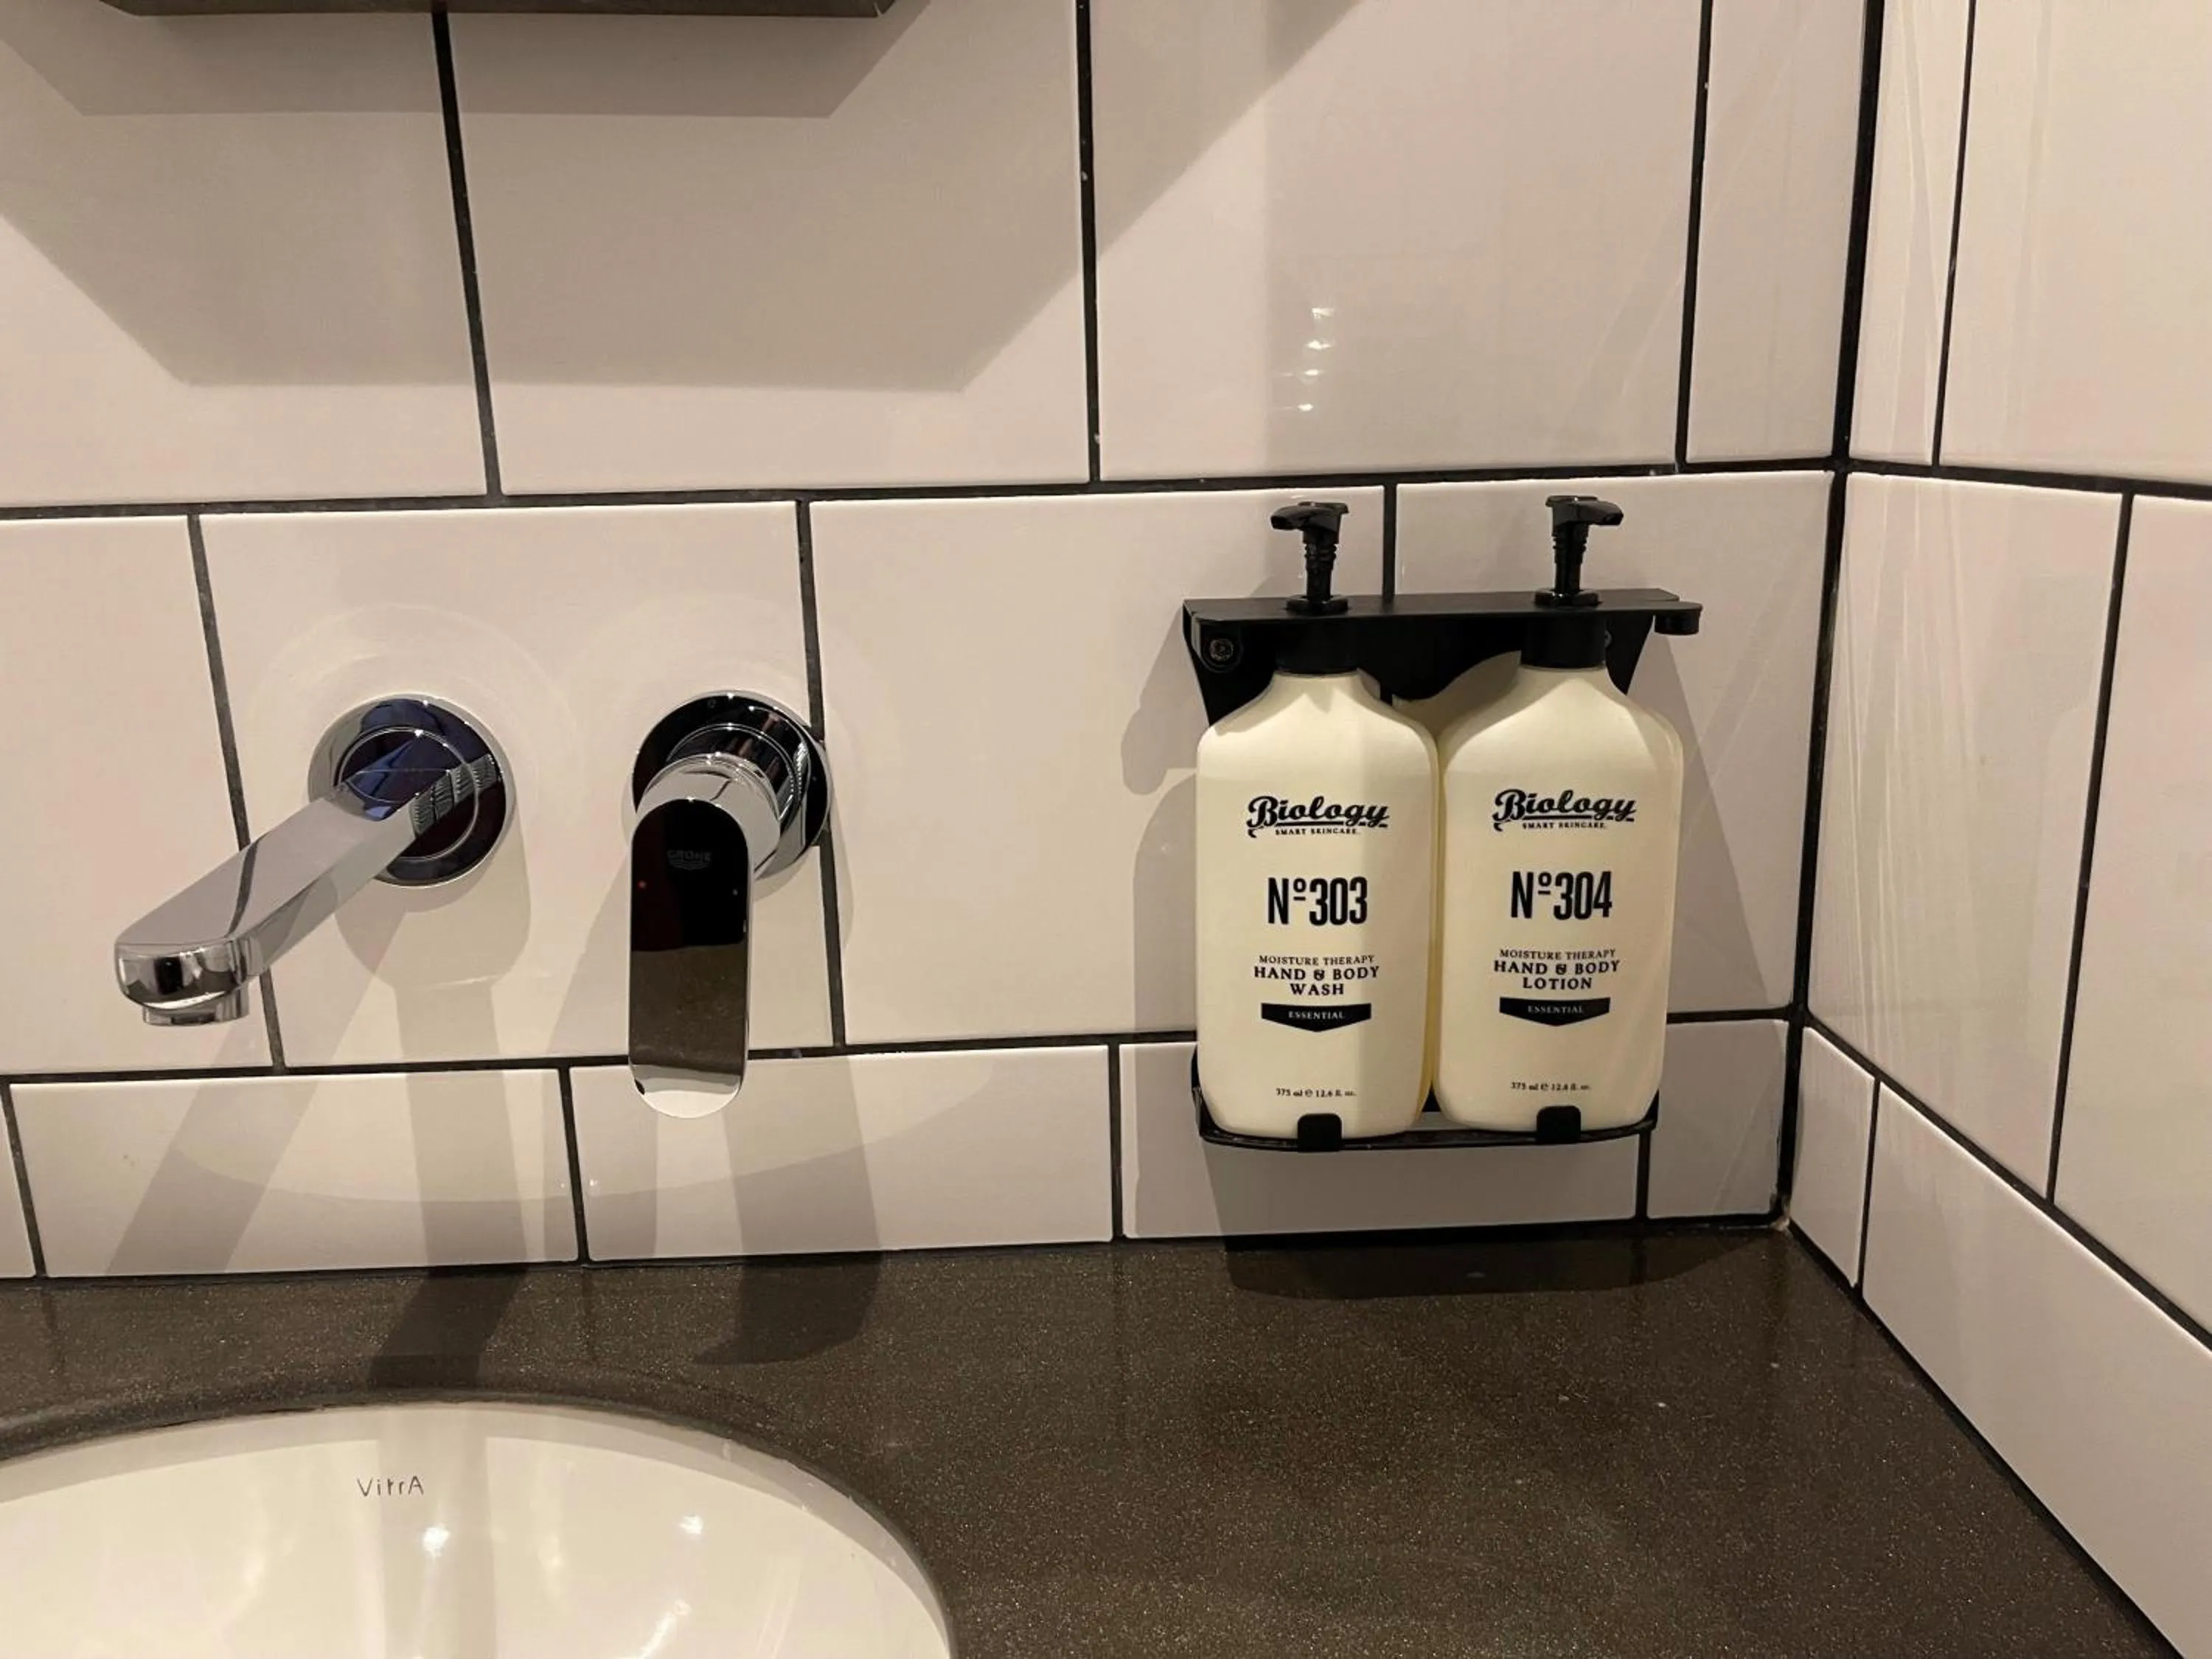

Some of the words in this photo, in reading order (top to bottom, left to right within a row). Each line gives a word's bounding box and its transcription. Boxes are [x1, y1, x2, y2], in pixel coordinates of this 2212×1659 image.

[1246, 796, 1390, 838] Biology
[1492, 789, 1637, 832] Biology
[1259, 955, 1319, 966] MOISTURE
[1324, 955, 1375, 966] THERAPY
[1500, 949, 1562, 960] MOISTURE
[1566, 949, 1616, 959] THERAPY
[1253, 966, 1306, 981] HAND
[1313, 970, 1325, 981] &
[1332, 966, 1380, 980] BODY
[1494, 960, 1548, 975] HAND
[1556, 964, 1568, 975] &
[1575, 960, 1621, 974] BODY
[1290, 983, 1345, 995] WASH
[1523, 977, 1593, 990] LOTION
[1288, 1011, 1345, 1020] ESSENTIAL
[1528, 1005, 1585, 1014] ESSENTIAL
[357, 1475, 424, 1497] VitrA
